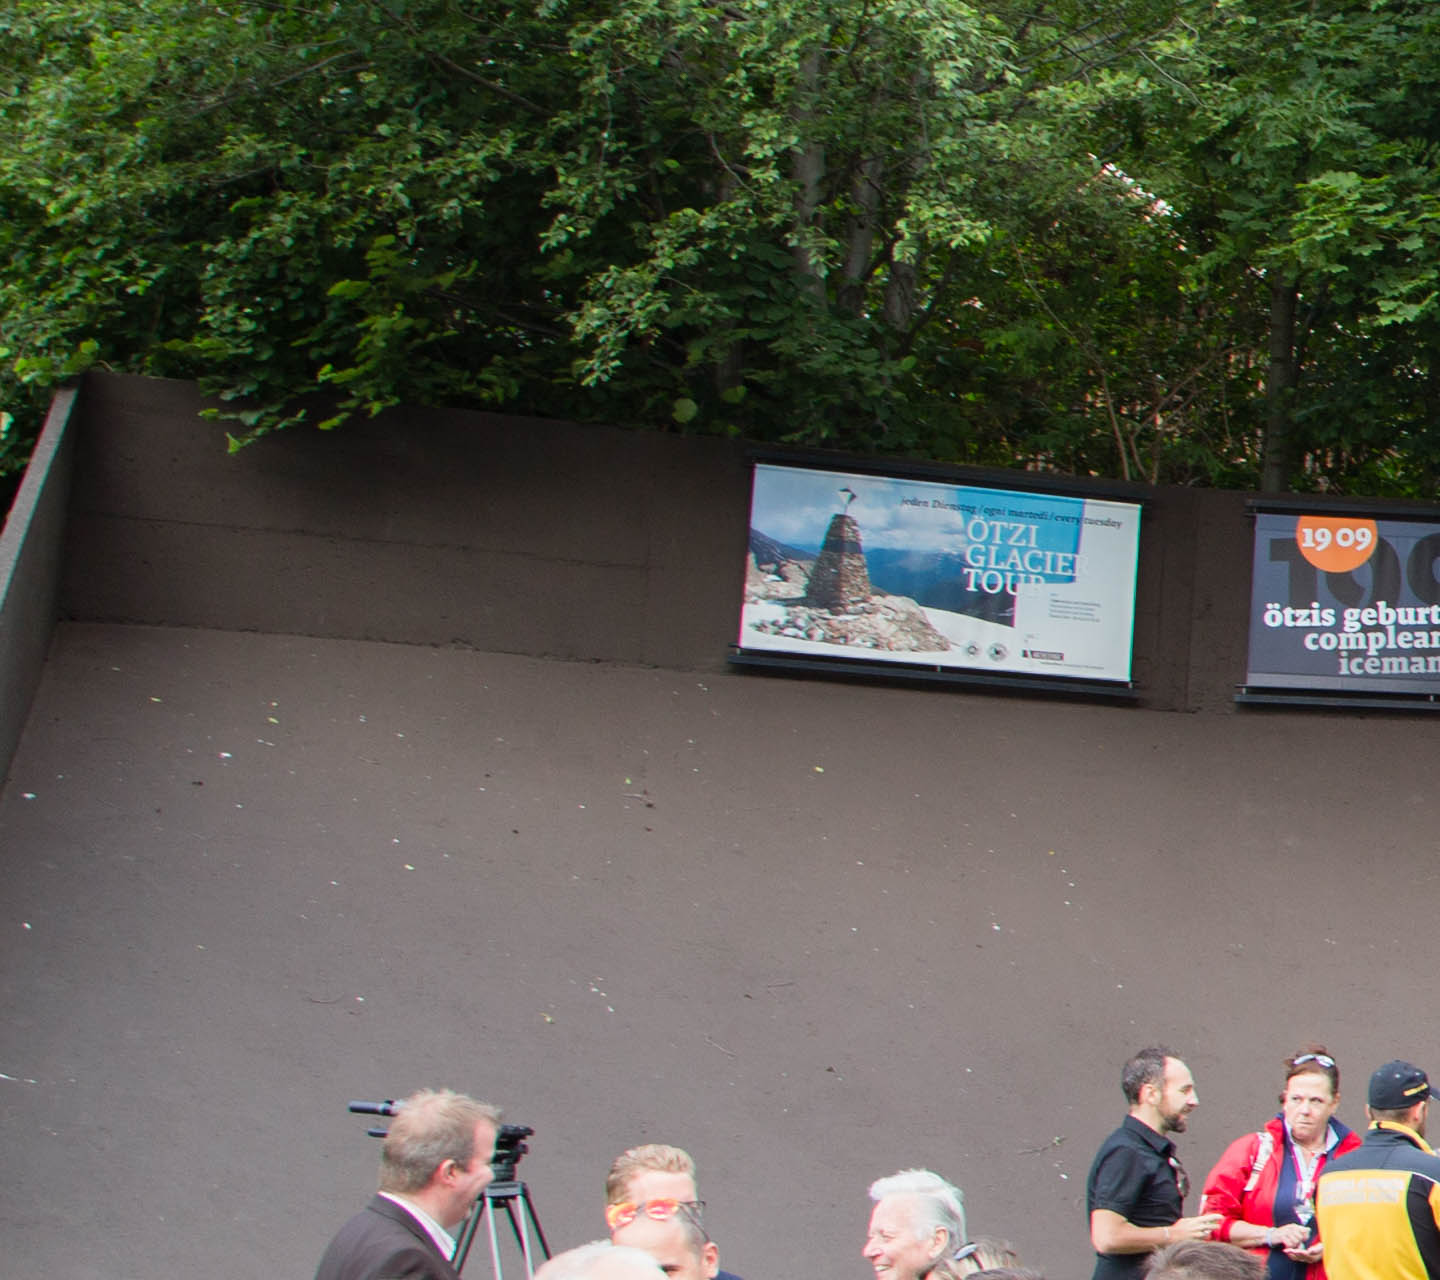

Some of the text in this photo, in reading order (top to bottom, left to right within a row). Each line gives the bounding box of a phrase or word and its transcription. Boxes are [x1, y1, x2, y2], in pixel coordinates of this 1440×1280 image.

[967, 515, 1040, 548] ÖTZI
[1302, 528, 1372, 551] 19 09
[1264, 602, 1336, 627] ötzis
